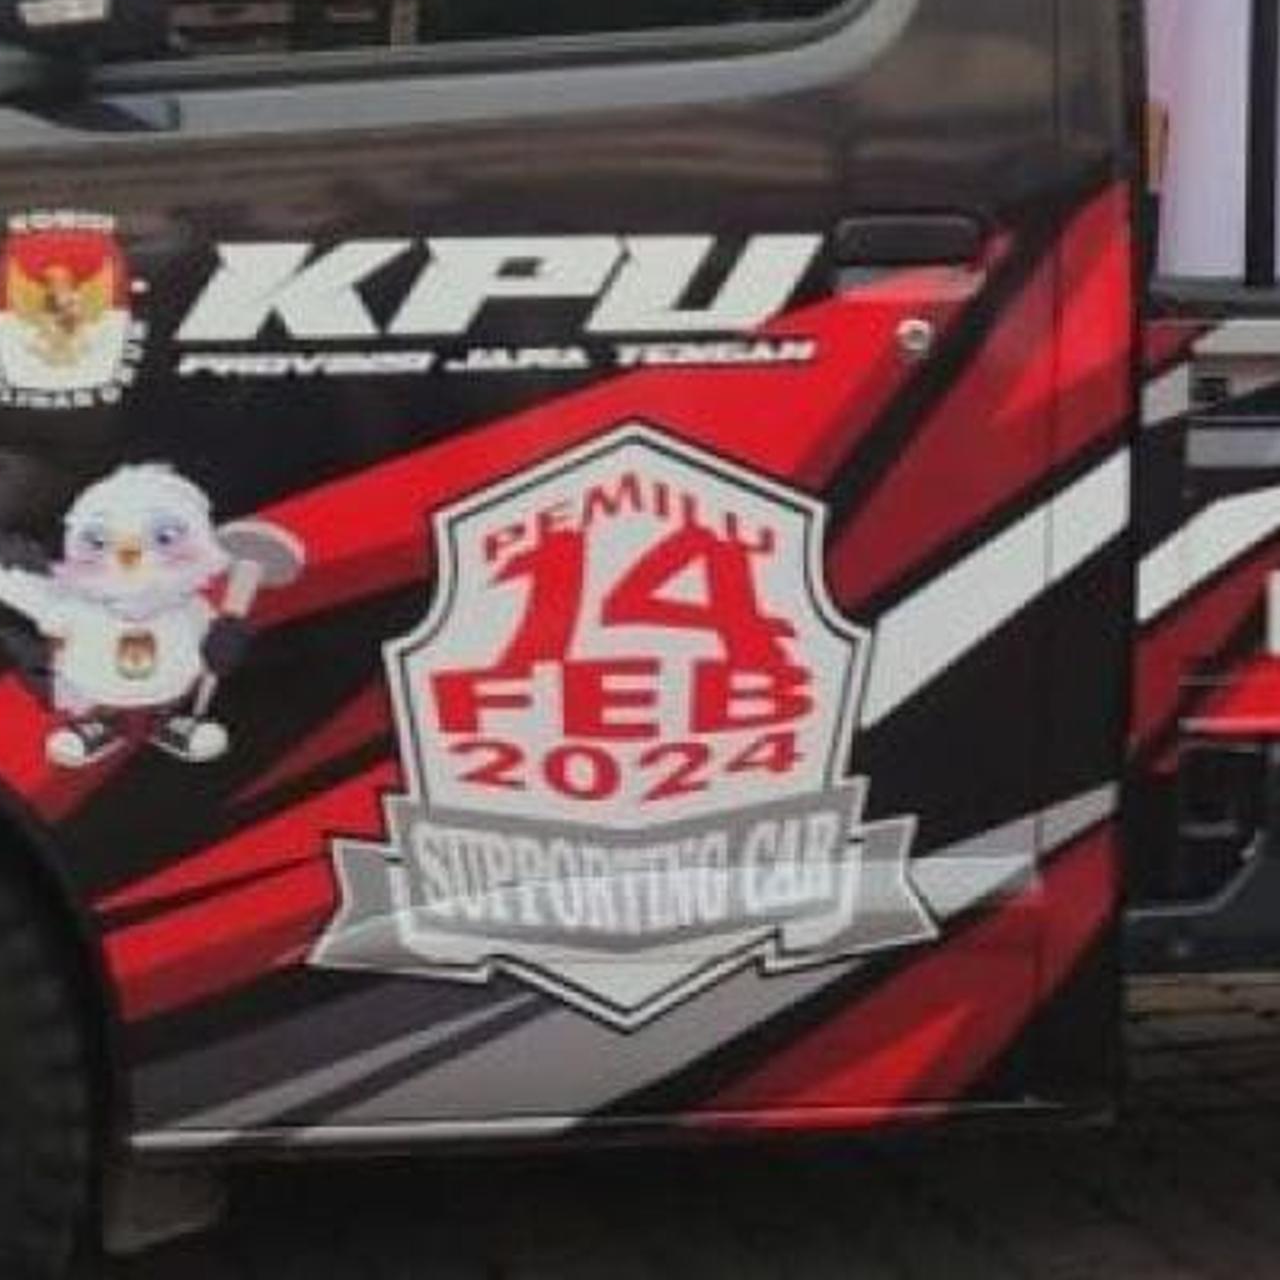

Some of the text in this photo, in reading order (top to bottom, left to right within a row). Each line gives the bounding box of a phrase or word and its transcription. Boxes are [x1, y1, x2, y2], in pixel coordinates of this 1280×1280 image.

[173, 232, 824, 342] KPU
[491, 522, 796, 668] 14
[430, 657, 812, 737] FEB
[448, 732, 802, 803] 2024
